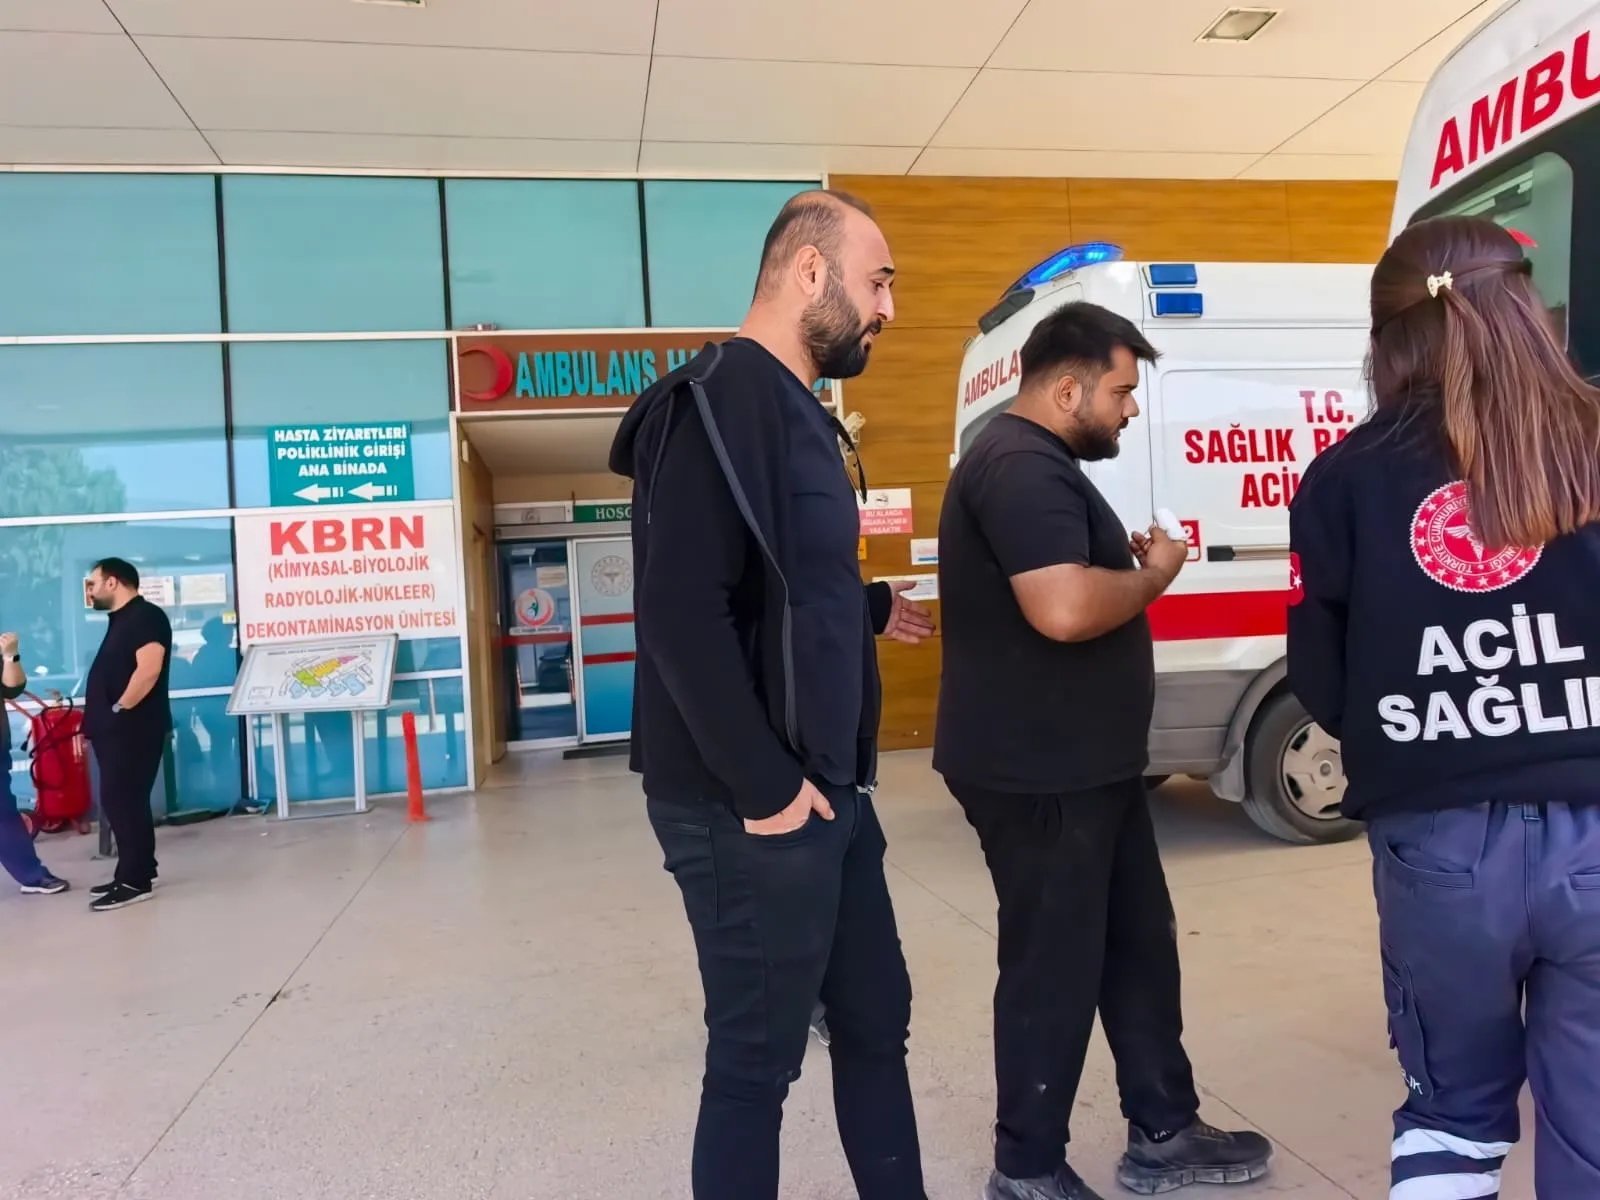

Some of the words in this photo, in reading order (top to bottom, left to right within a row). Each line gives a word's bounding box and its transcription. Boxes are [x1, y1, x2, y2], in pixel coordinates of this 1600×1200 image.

[516, 349, 658, 398] AMBULANS
[964, 350, 1019, 408] AMBULA
[1299, 390, 1353, 423] T.C.
[274, 429, 320, 442] HASTA
[323, 425, 407, 440] ZİYARETLERİ
[1184, 422, 1296, 464] SAĞLIK
[277, 444, 360, 460] POLİKLİNİK
[363, 442, 406, 459] GİRİŞİ
[298, 463, 330, 477] ANA
[333, 460, 387, 476] BİNADA
[269, 515, 425, 556] KBRN
[268, 552, 430, 582] (KİMYASAL-BİYOLOJİK
[264, 583, 436, 609] RADYOLOJİK-NÜKLEER)
[246, 614, 395, 639] DEKONTAMİNASYON
[399, 608, 456, 629] ÜNİTESİ
[1417, 603, 1585, 675] ACİL
